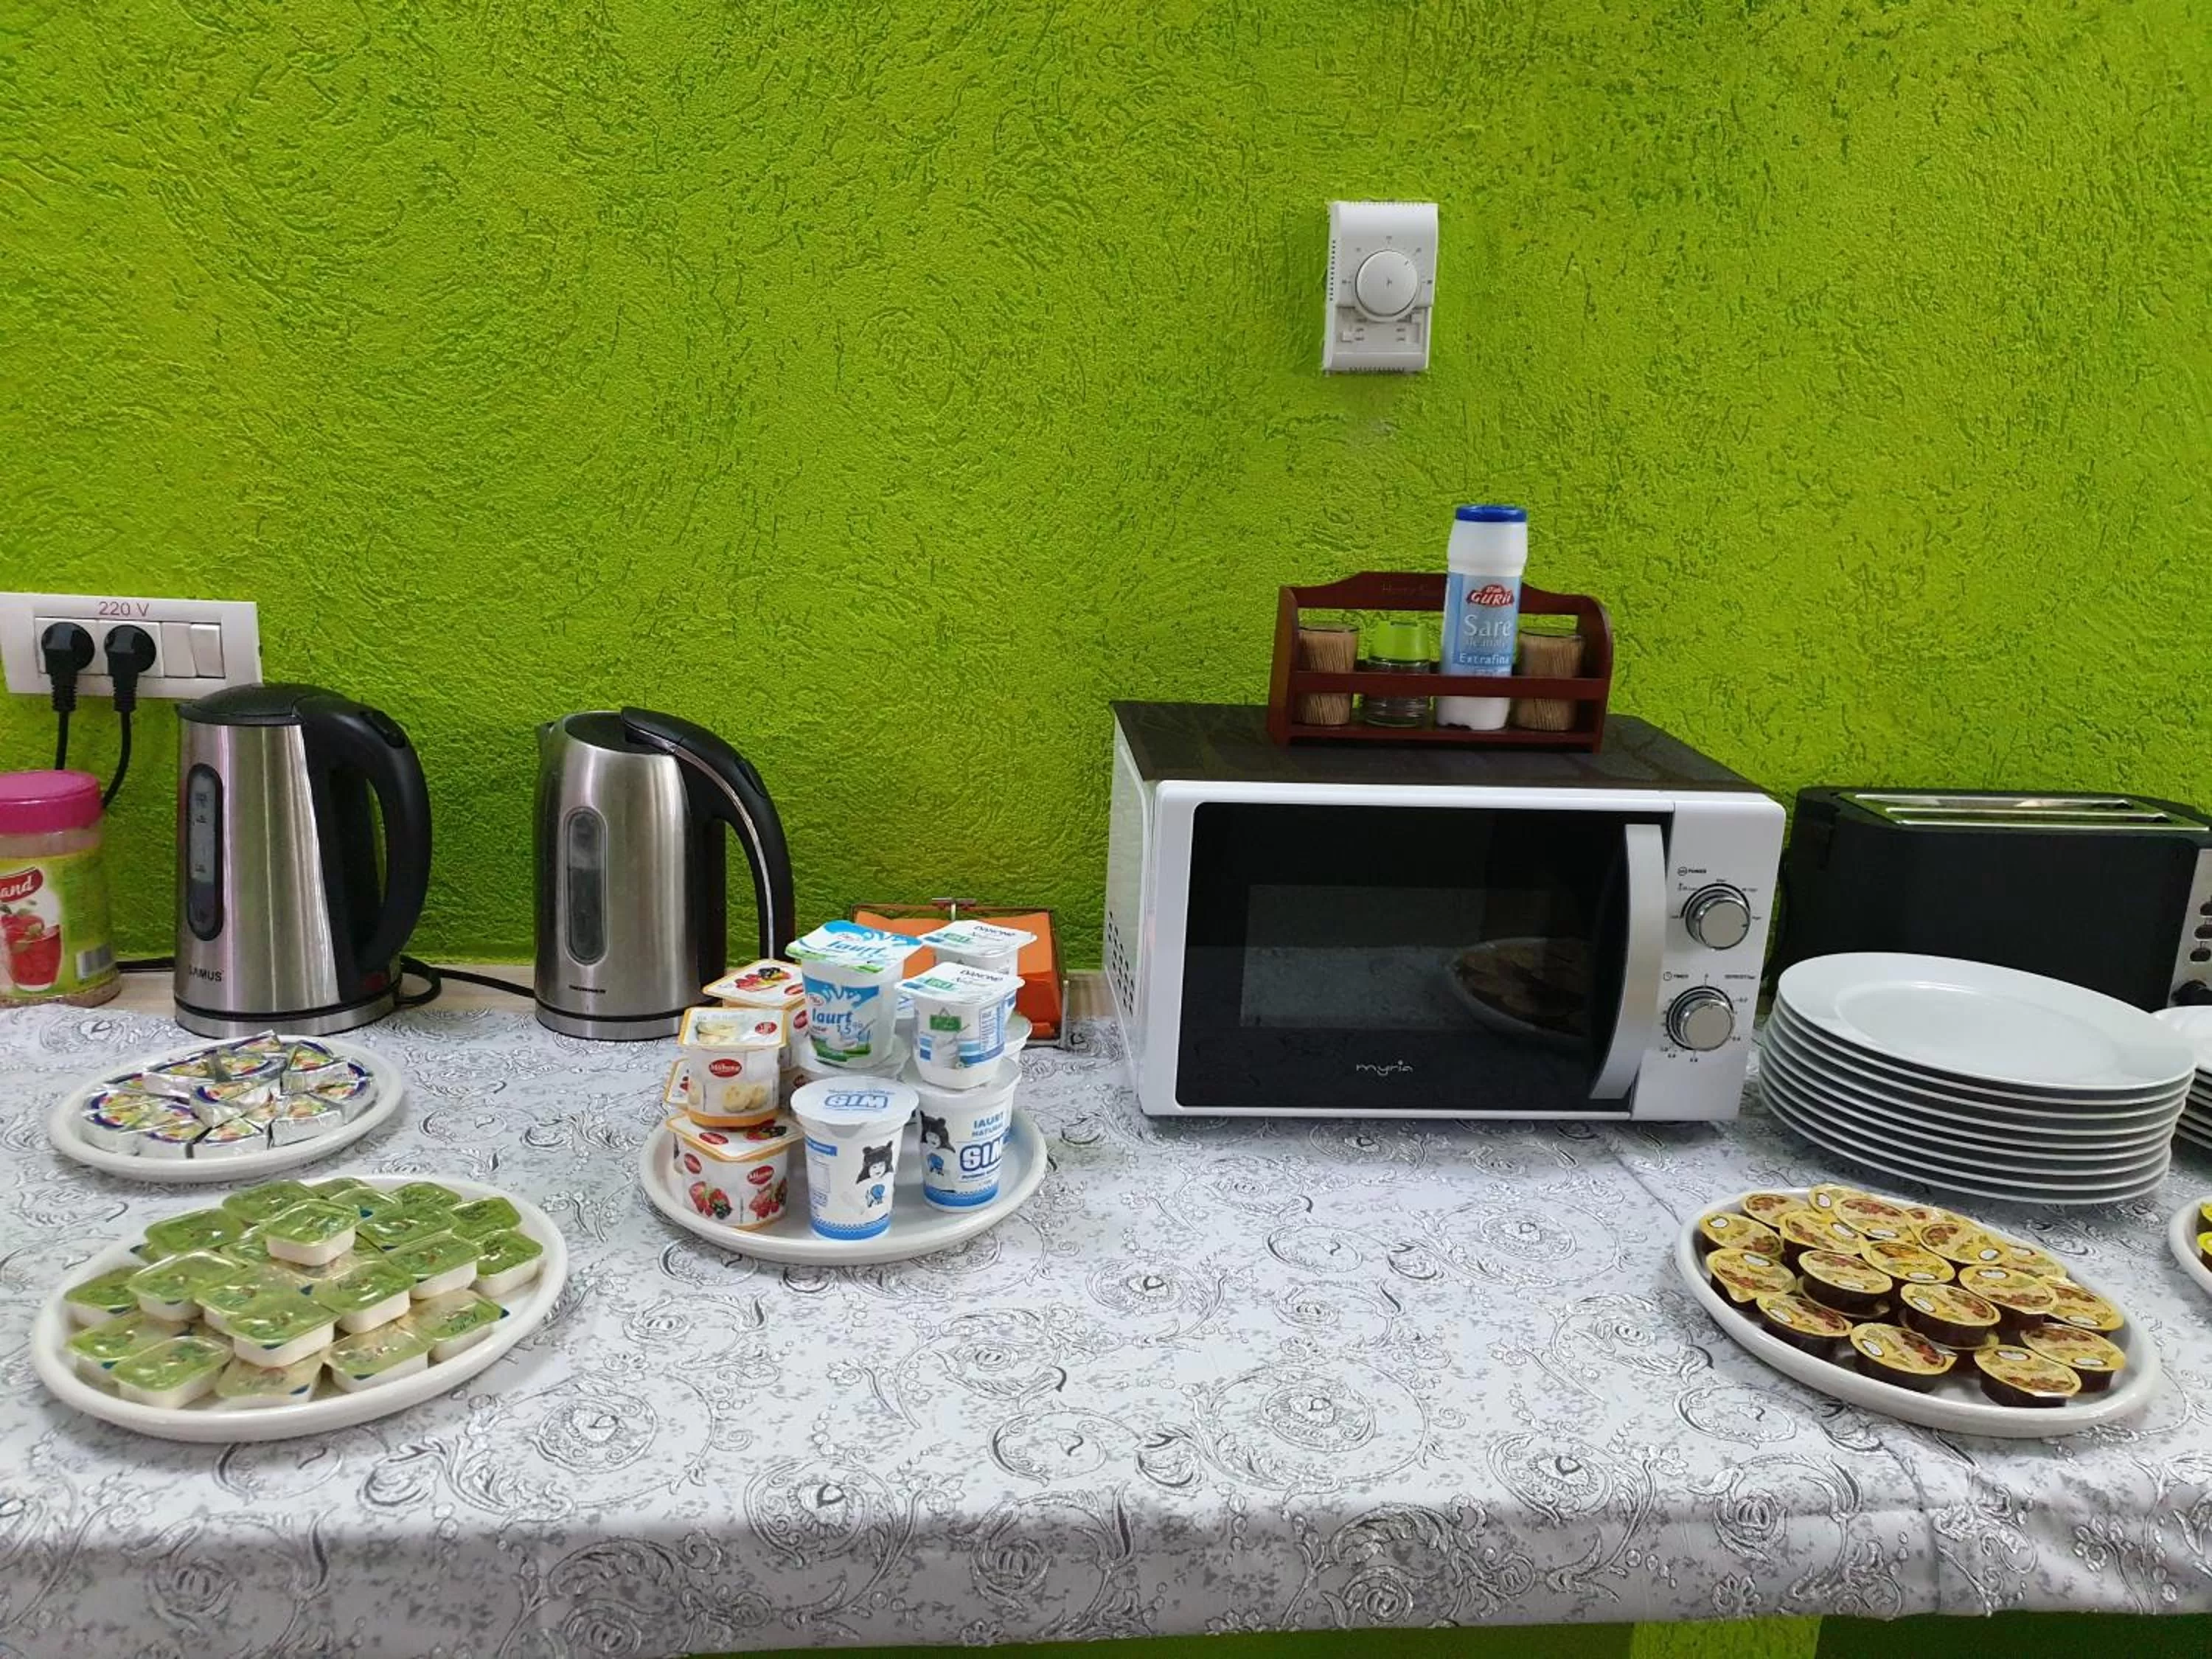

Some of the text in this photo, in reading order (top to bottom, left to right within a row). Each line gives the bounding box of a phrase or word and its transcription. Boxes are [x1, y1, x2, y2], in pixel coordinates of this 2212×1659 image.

[98, 601, 150, 617] 220 V
[1464, 614, 1512, 636] Sare
[812, 1007, 853, 1024] Iaurt
[1356, 1060, 1414, 1077] myria
